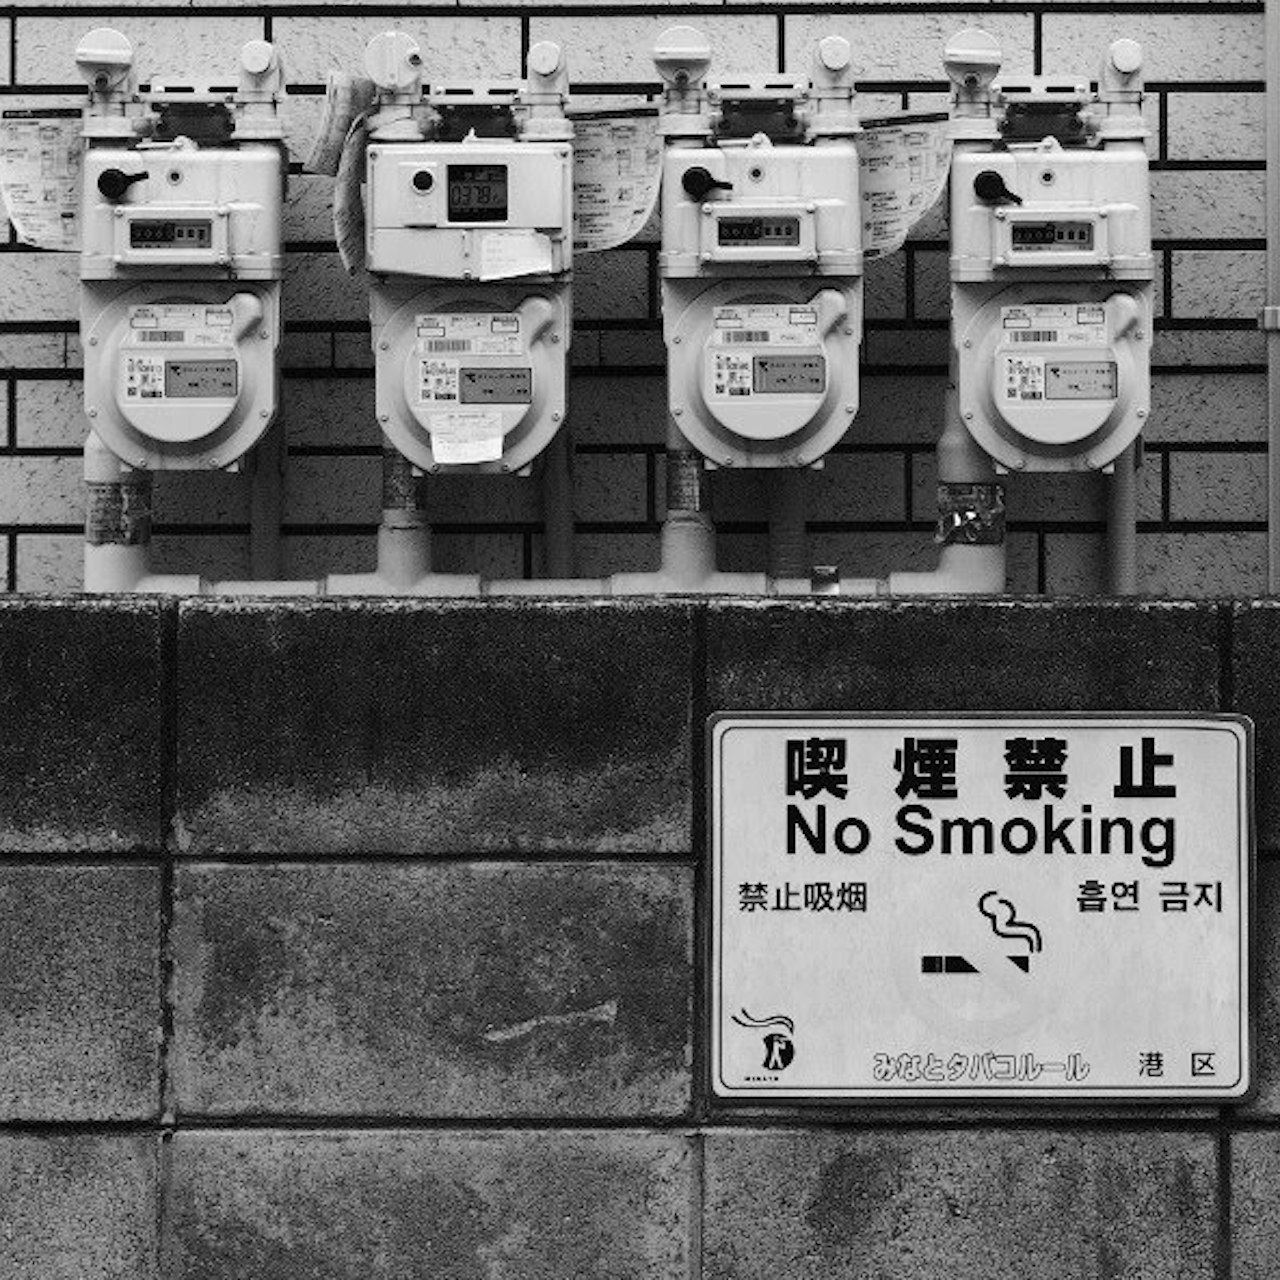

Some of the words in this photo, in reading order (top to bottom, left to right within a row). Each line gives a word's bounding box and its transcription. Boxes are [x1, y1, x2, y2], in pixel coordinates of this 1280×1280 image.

[785, 737, 1177, 801] 喫煙禁止
[786, 804, 871, 856] No
[894, 804, 1175, 869] Smoking
[738, 882, 868, 913] 禁止吸烟
[1076, 880, 1141, 913] 흡연
[1159, 881, 1223, 913] 금지
[872, 1051, 1091, 1082] みなとタバコルール
[1139, 1051, 1216, 1077] 港区
